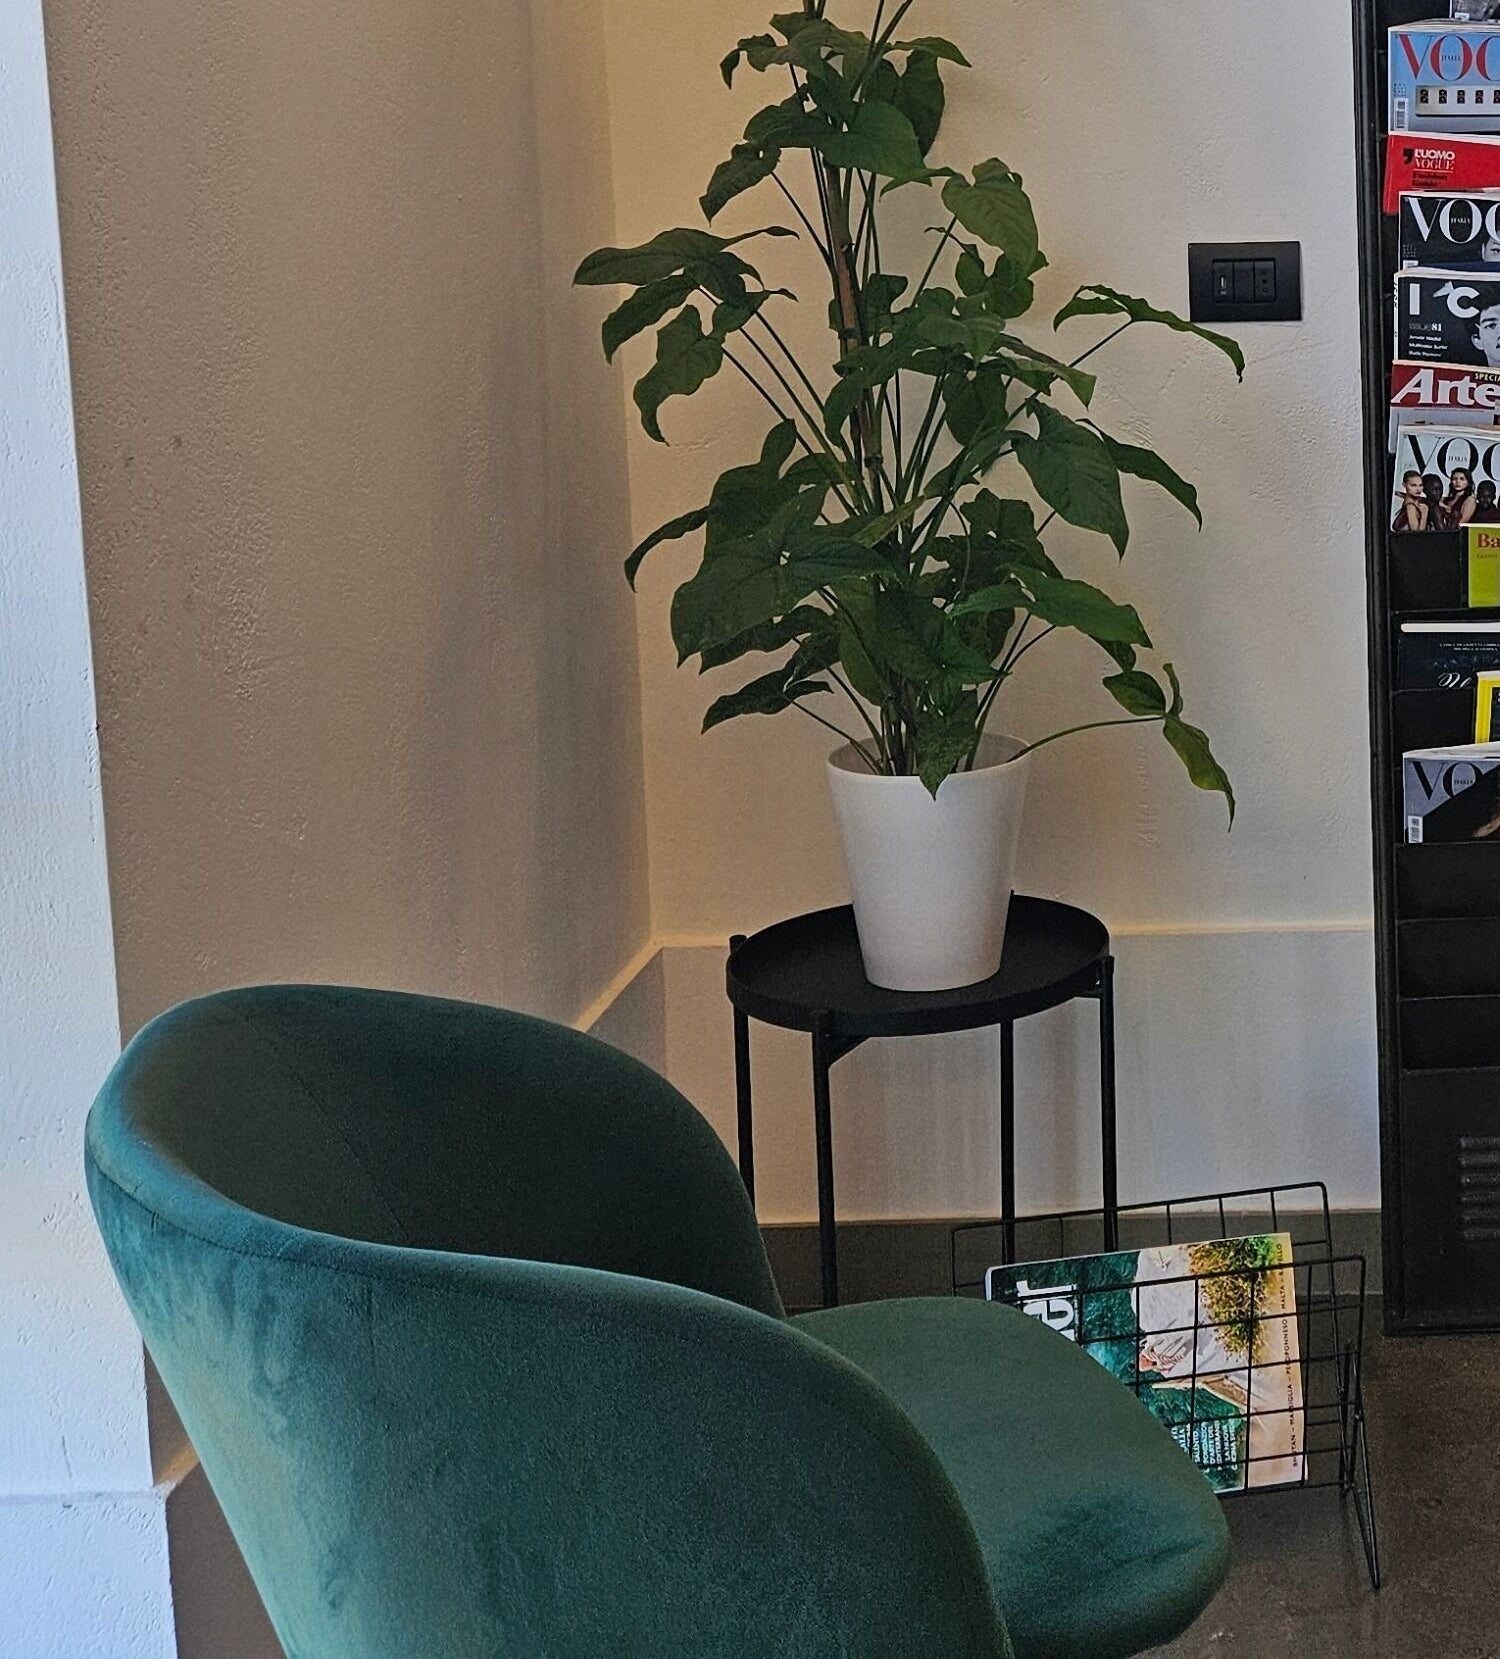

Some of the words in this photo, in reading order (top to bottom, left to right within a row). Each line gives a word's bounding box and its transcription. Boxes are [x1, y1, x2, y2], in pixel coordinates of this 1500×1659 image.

[1414, 148, 1456, 160] L'UOMO
[1415, 158, 1455, 170] VOGUE
[1229, 1441, 1238, 1471] CCINA
